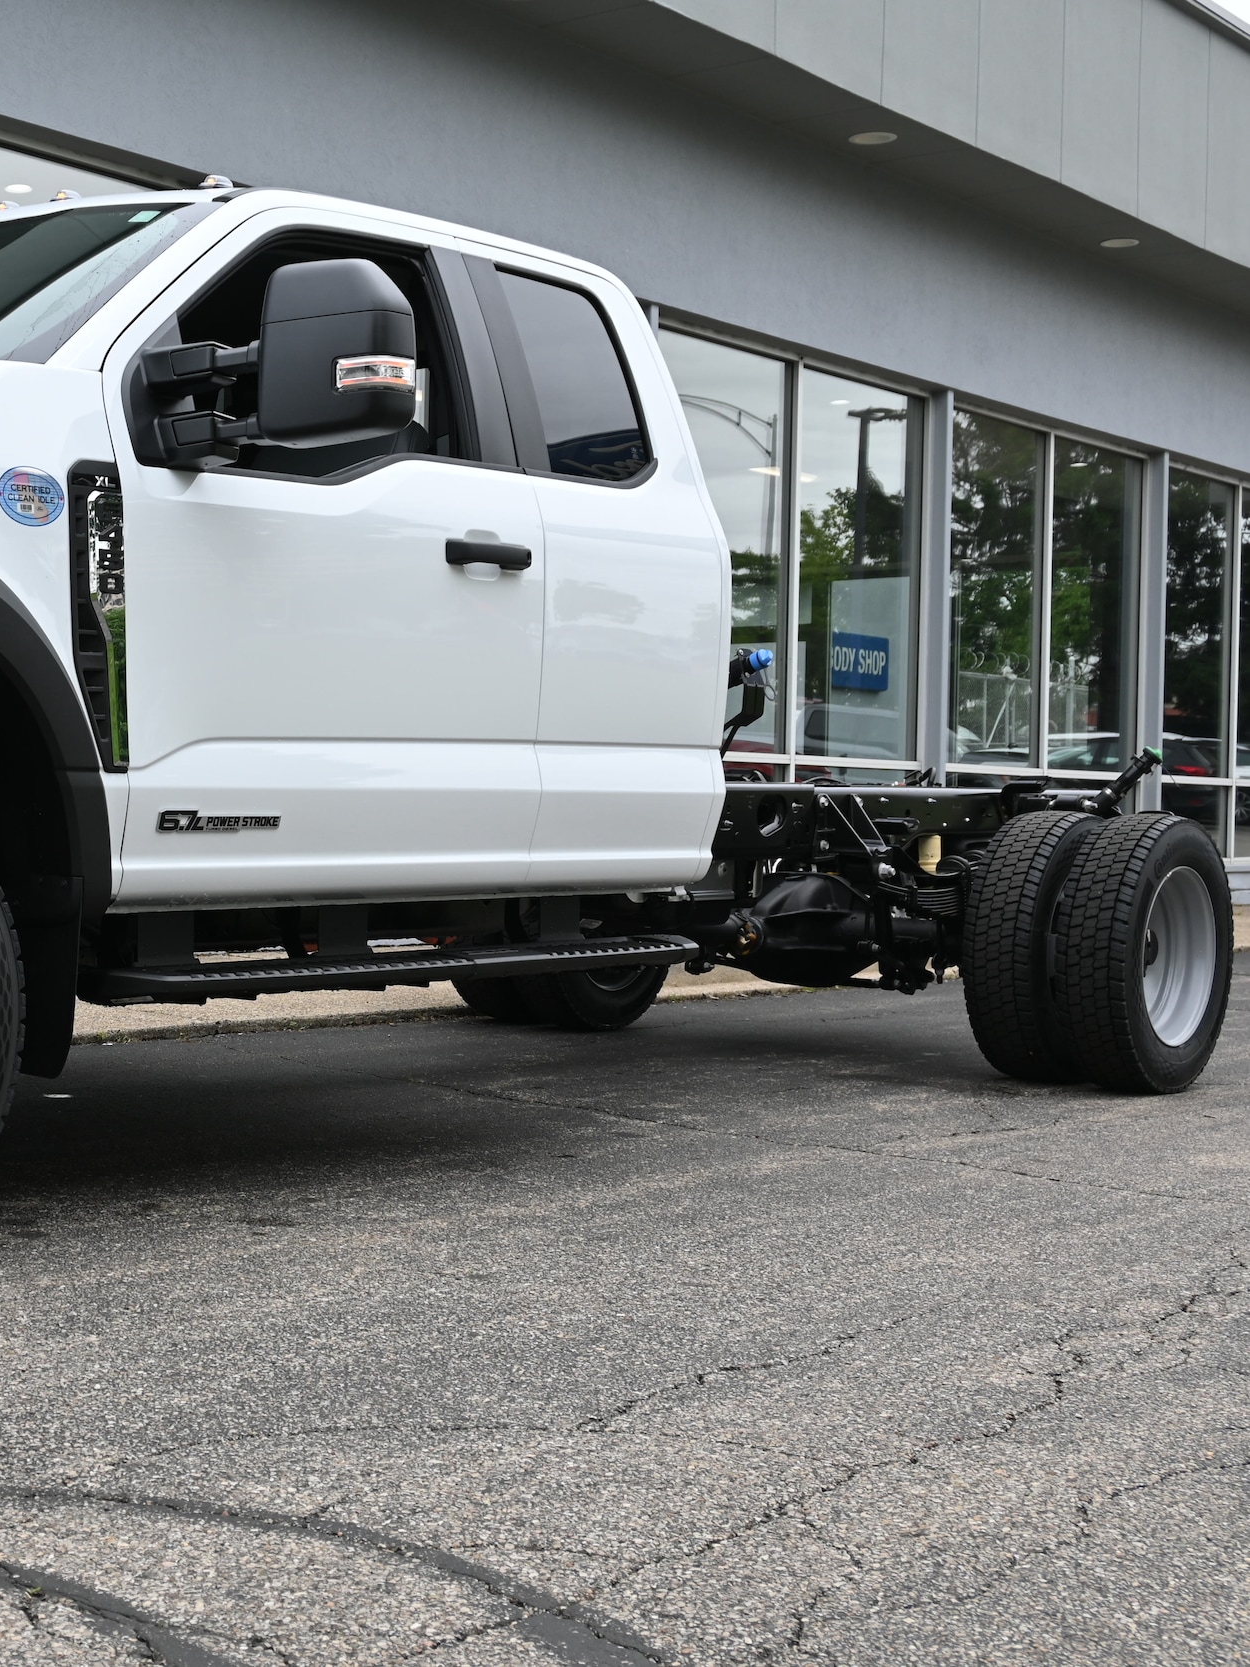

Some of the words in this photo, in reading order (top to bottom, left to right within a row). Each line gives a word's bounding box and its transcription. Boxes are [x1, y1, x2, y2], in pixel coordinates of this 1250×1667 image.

[94, 475, 116, 488] XL
[10, 483, 51, 495] CERTIFIED
[7, 493, 35, 503] CLEAN
[37, 495, 56, 505] IDLE
[858, 648, 886, 675] SHOP
[158, 810, 204, 831] 6.7L
[206, 816, 241, 827] POWER
[241, 816, 280, 827] STROKE
